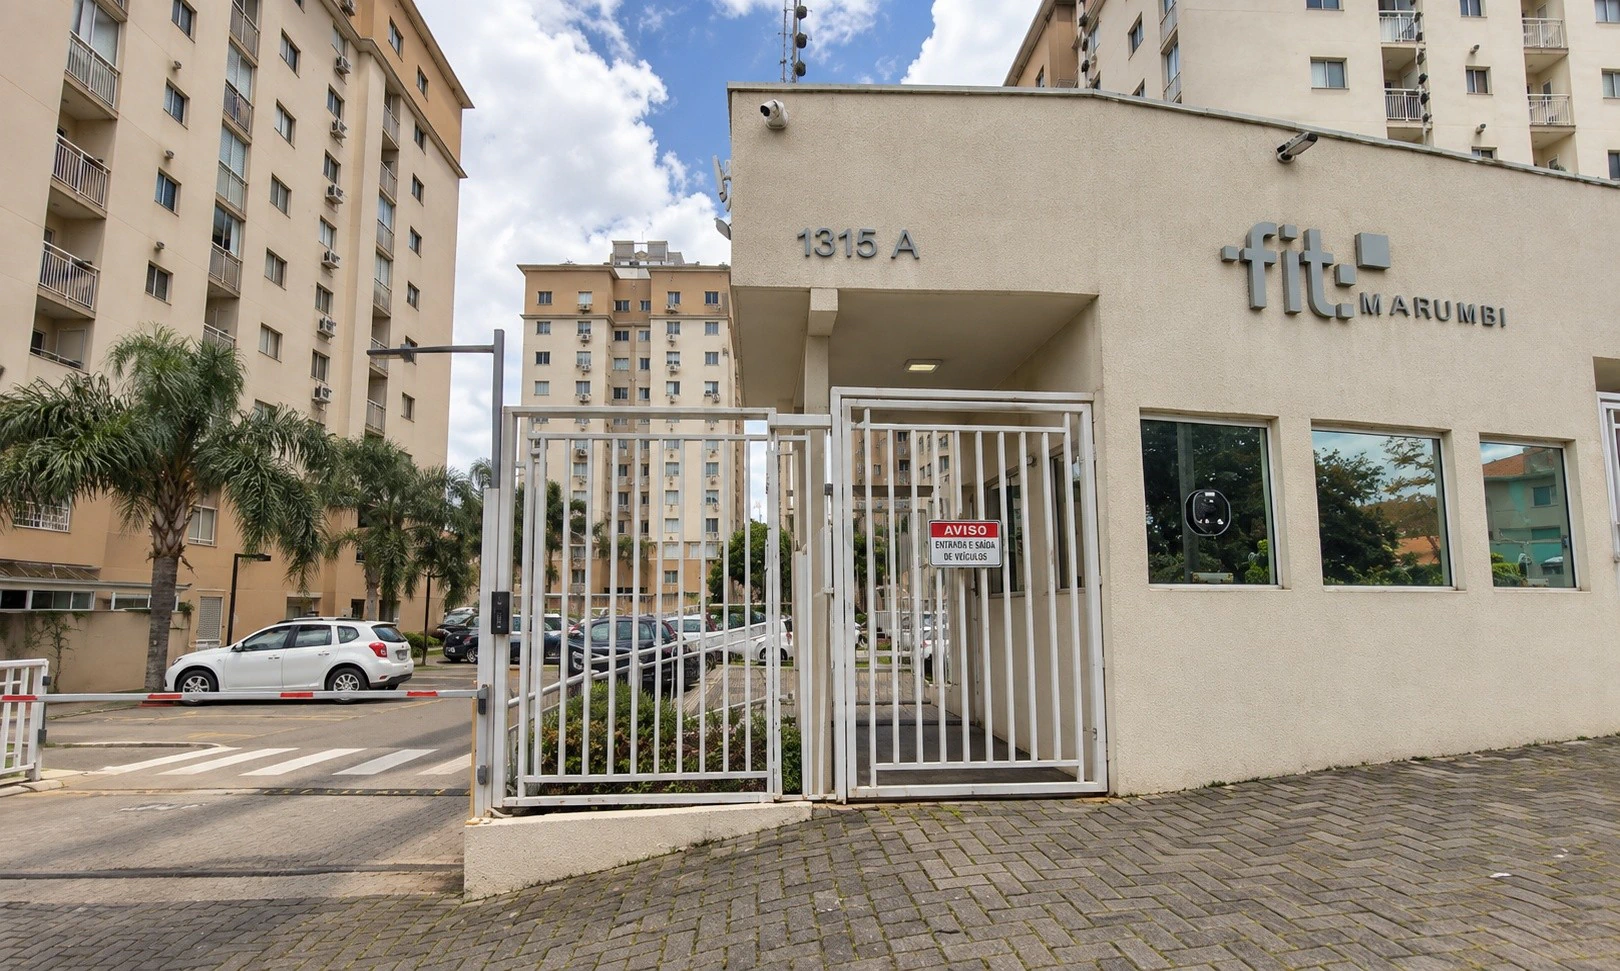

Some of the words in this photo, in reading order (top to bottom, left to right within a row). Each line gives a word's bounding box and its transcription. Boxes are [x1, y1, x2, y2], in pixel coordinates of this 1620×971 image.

[797, 228, 877, 258] 1315
[891, 229, 920, 259] A
[1239, 222, 1336, 318] fit
[1359, 291, 1507, 328] MARUMBI
[944, 525, 987, 536] AVISO
[935, 541, 967, 549] ENTRADA
[969, 541, 973, 549] E
[944, 553, 952, 561] DE
